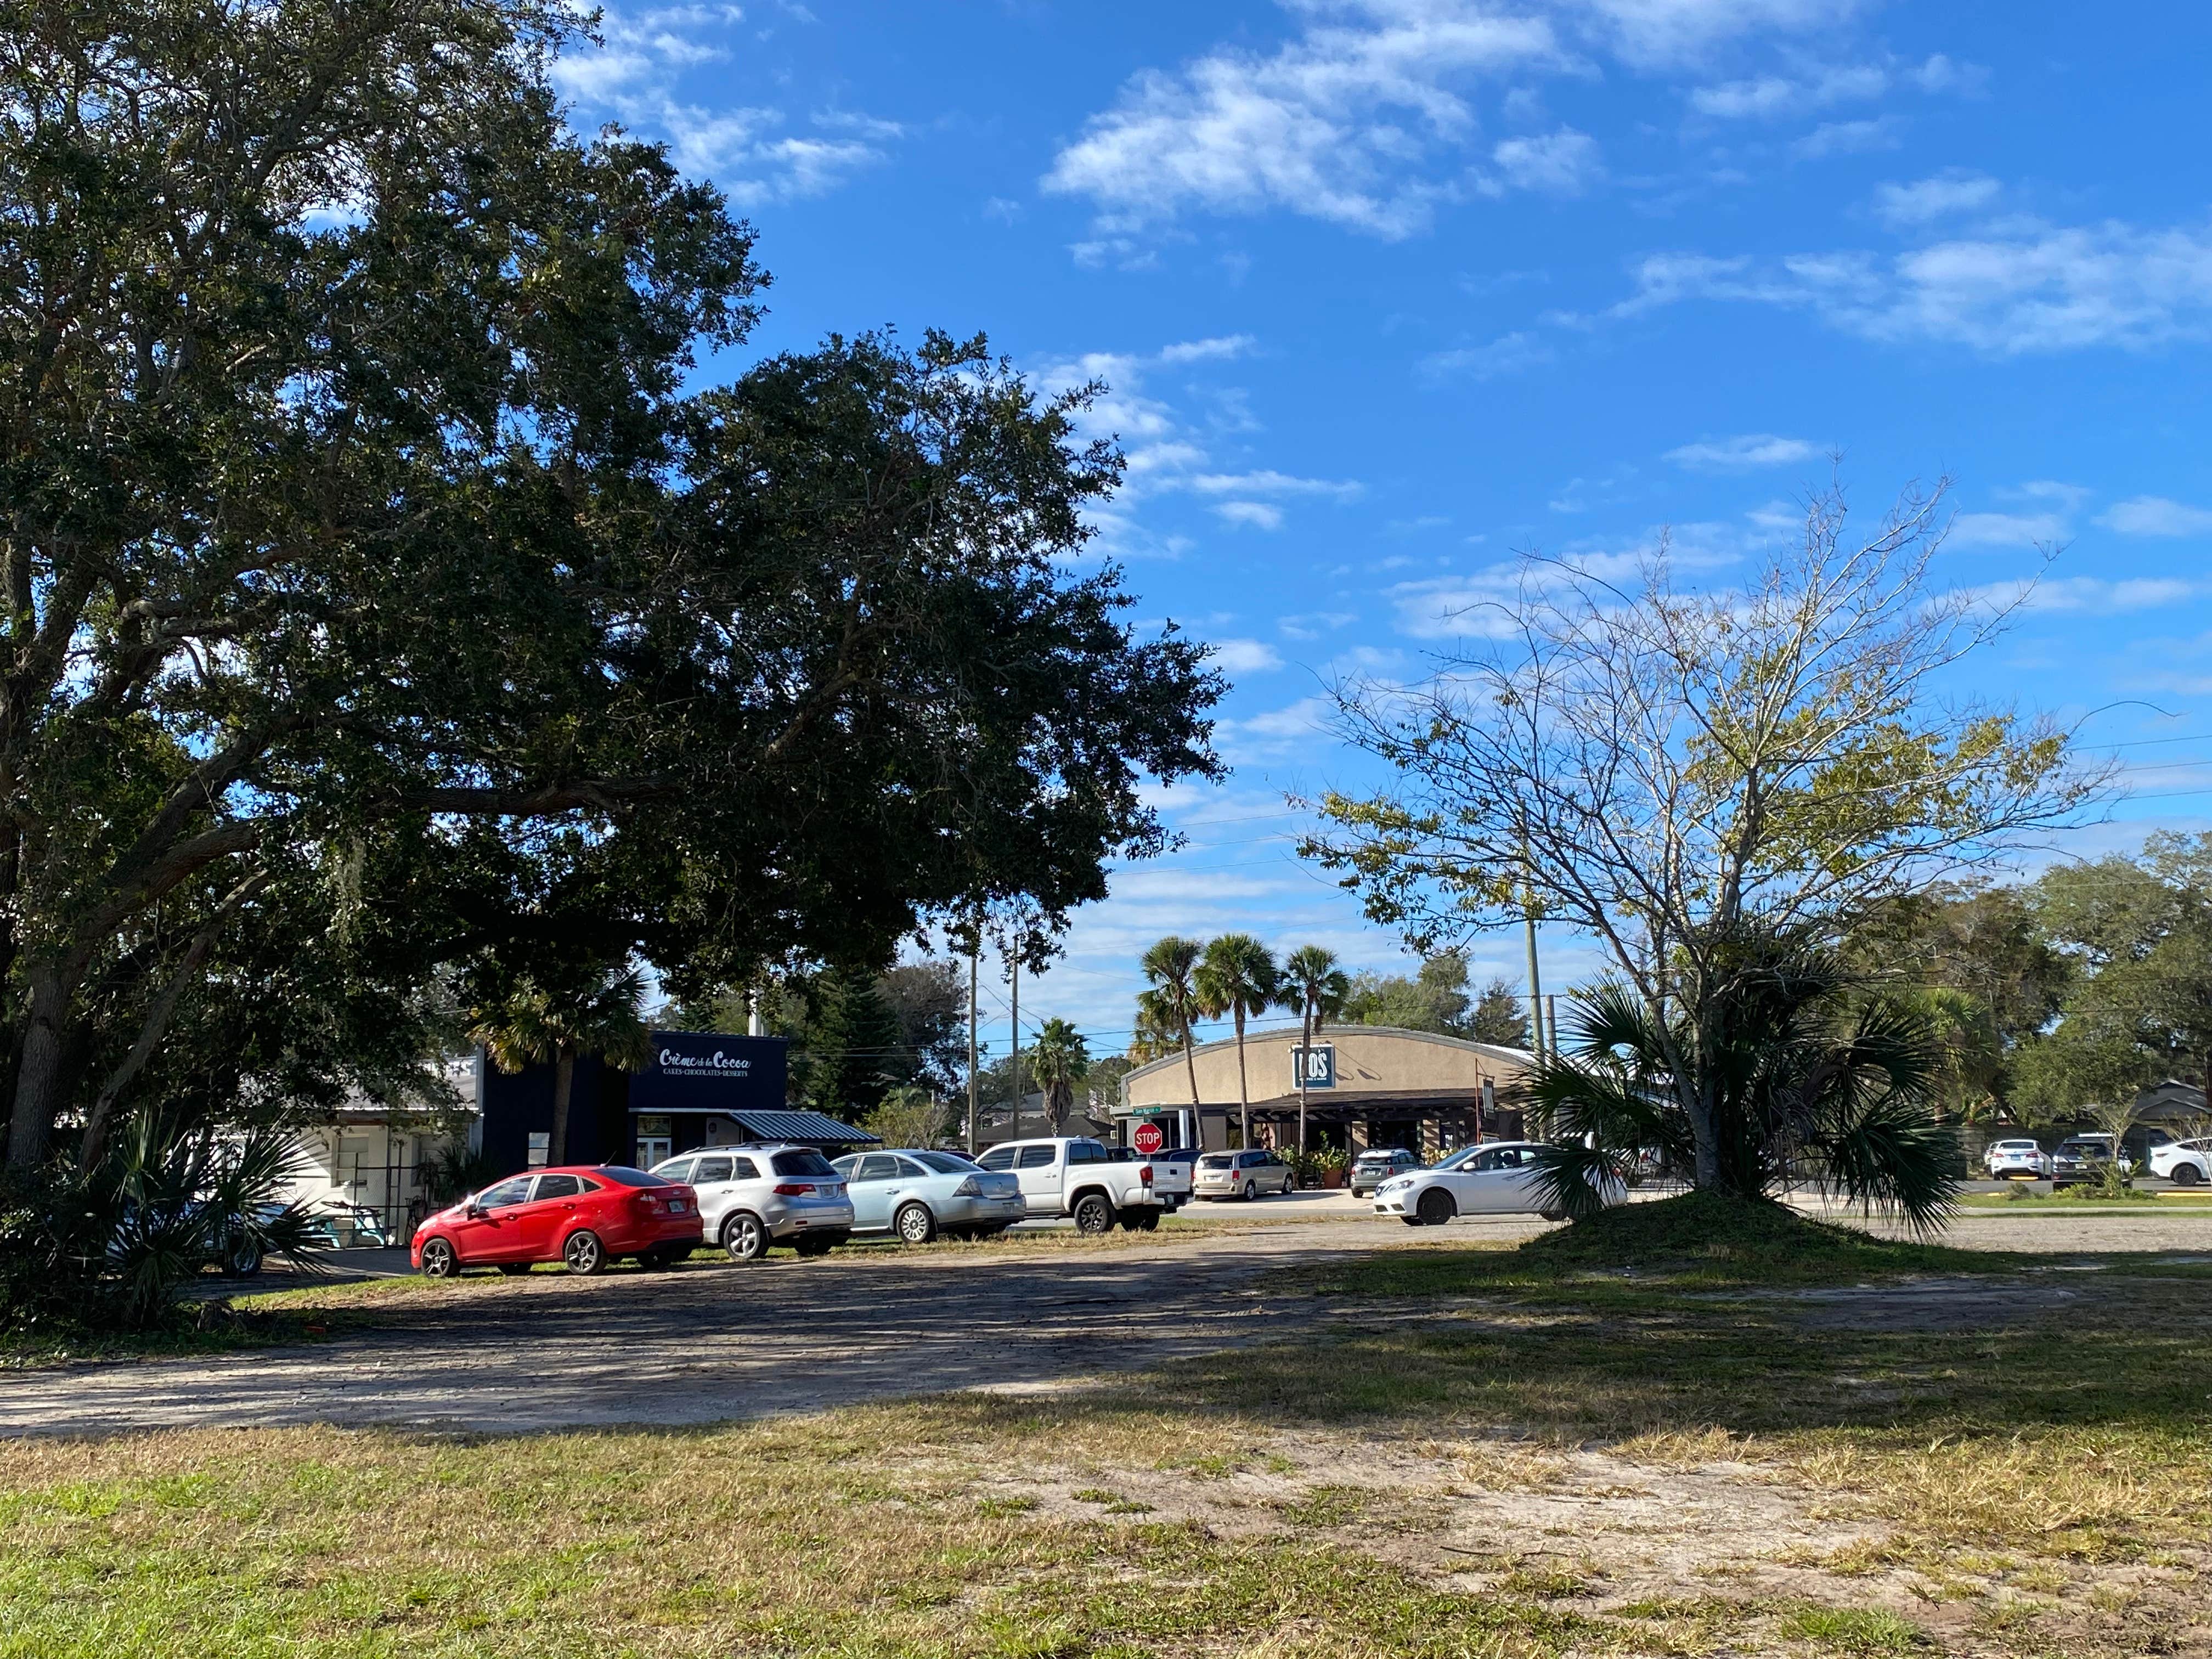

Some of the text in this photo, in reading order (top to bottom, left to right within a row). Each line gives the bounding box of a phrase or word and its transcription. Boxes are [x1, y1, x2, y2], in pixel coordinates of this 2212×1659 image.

[659, 1048, 698, 1066] Crème
[713, 1051, 751, 1068] Cocoa
[1136, 1132, 1160, 1145] STOP
